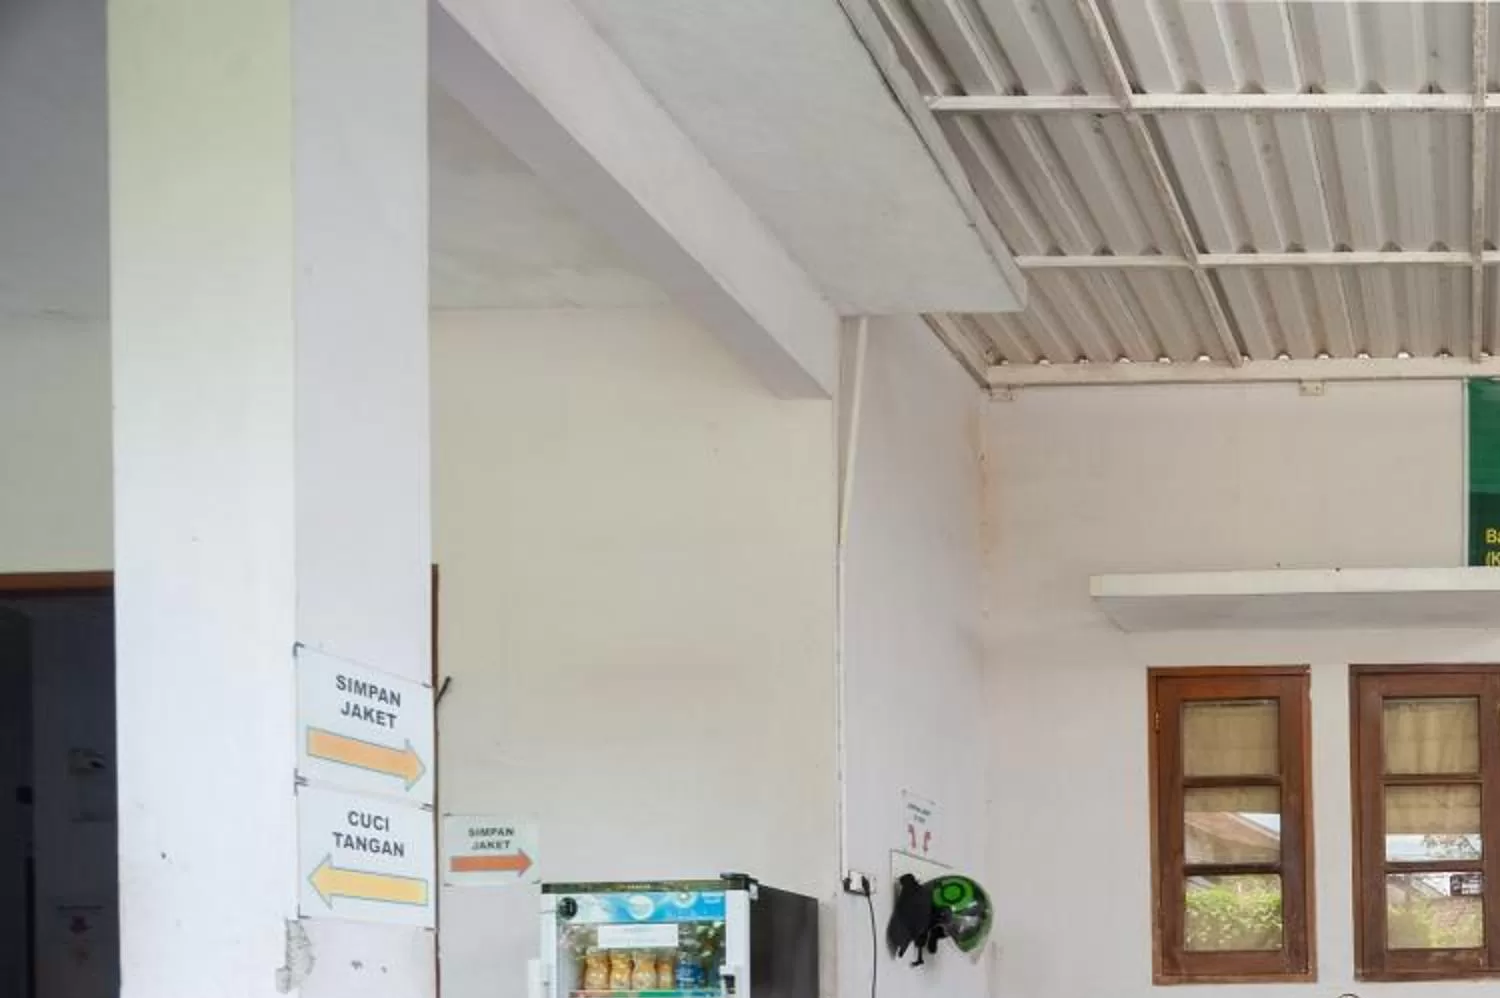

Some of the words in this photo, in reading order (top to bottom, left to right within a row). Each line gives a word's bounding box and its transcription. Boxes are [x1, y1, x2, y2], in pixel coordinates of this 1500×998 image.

[335, 674, 401, 708] SIMPAN
[341, 701, 397, 730] JAKET
[347, 810, 390, 832] CUCI
[467, 827, 515, 837] SIMPAN
[332, 831, 405, 857] TANGAN
[472, 840, 511, 850] JAKET
